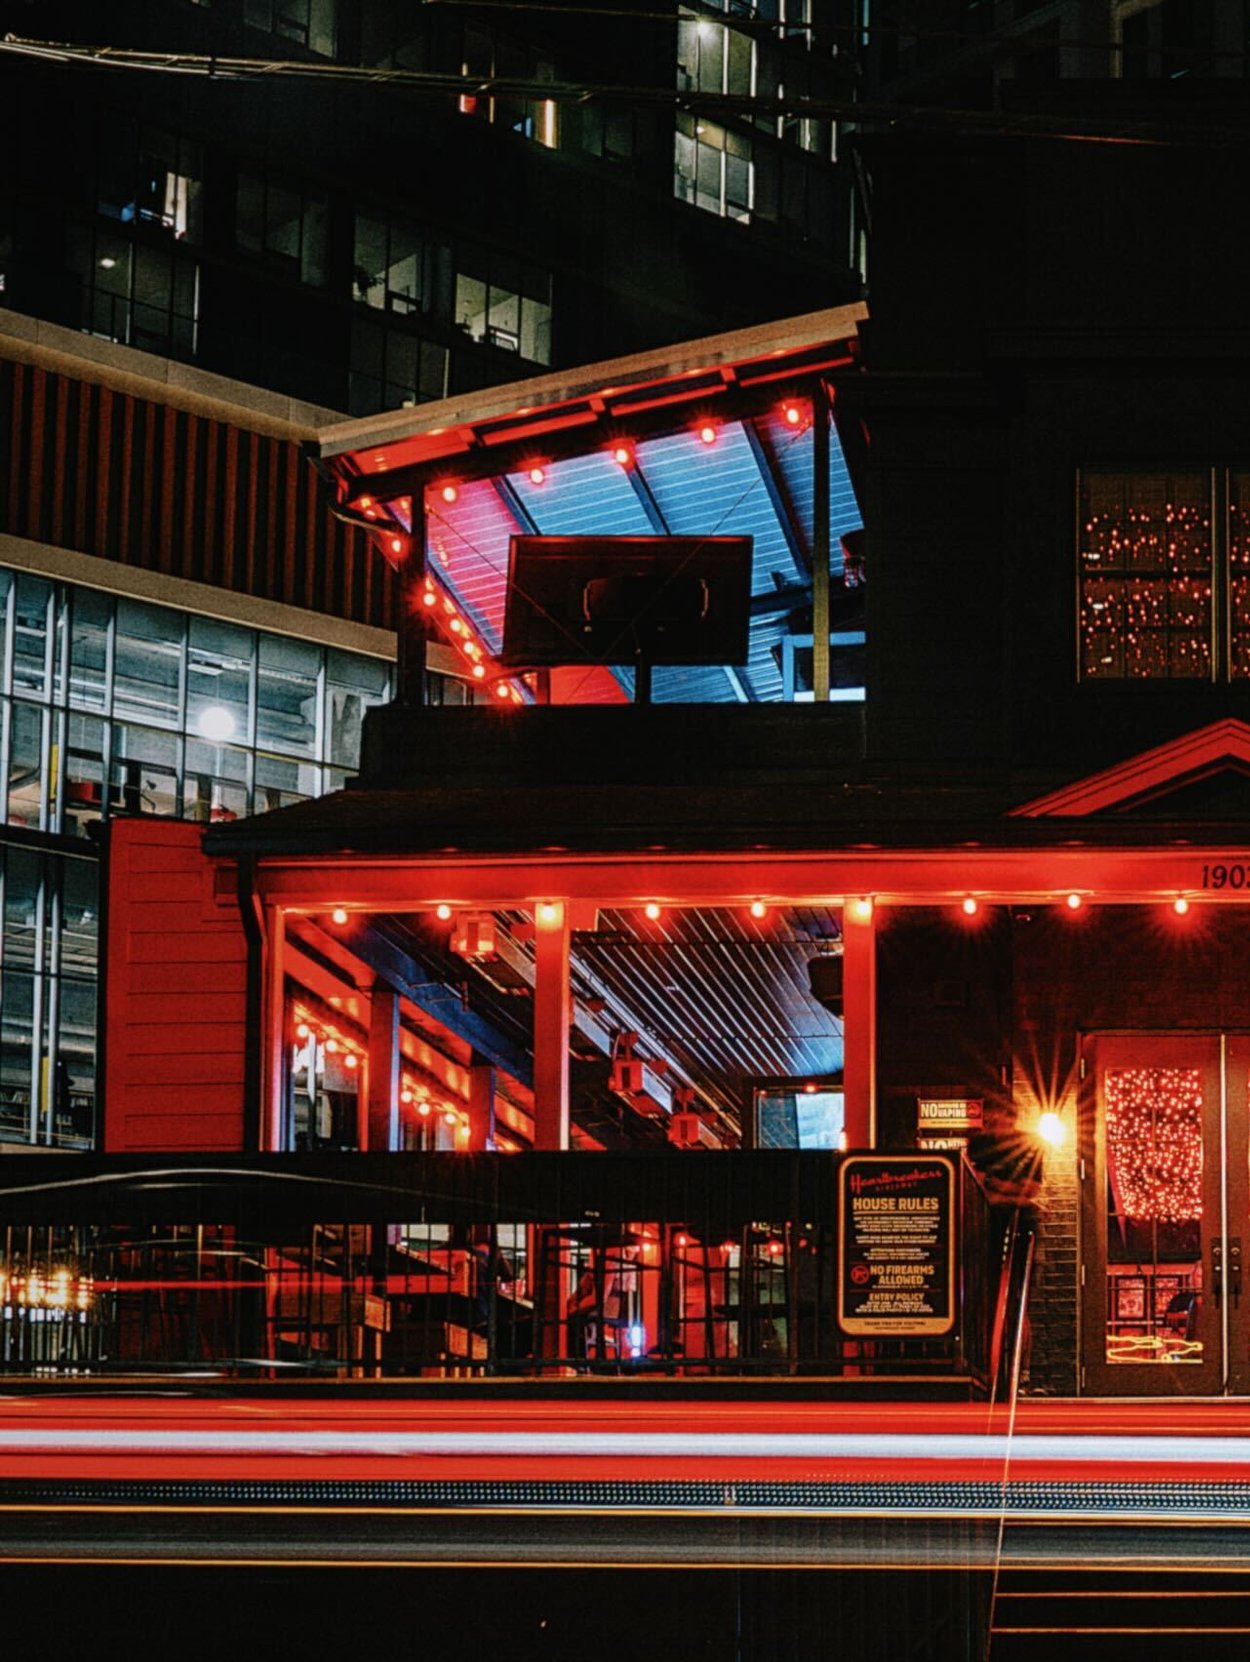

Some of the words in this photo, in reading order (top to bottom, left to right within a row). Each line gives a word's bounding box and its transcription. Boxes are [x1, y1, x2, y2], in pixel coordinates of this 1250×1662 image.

[920, 1103, 938, 1118] NO
[853, 1197, 896, 1210] HOUSE
[898, 1197, 939, 1210] RULES
[870, 1265, 885, 1275] NO
[886, 1265, 934, 1275] FIREARMS
[878, 1275, 924, 1285] ALLOWED
[869, 1293, 895, 1301] ENTRY
[896, 1293, 925, 1301] POLICY
